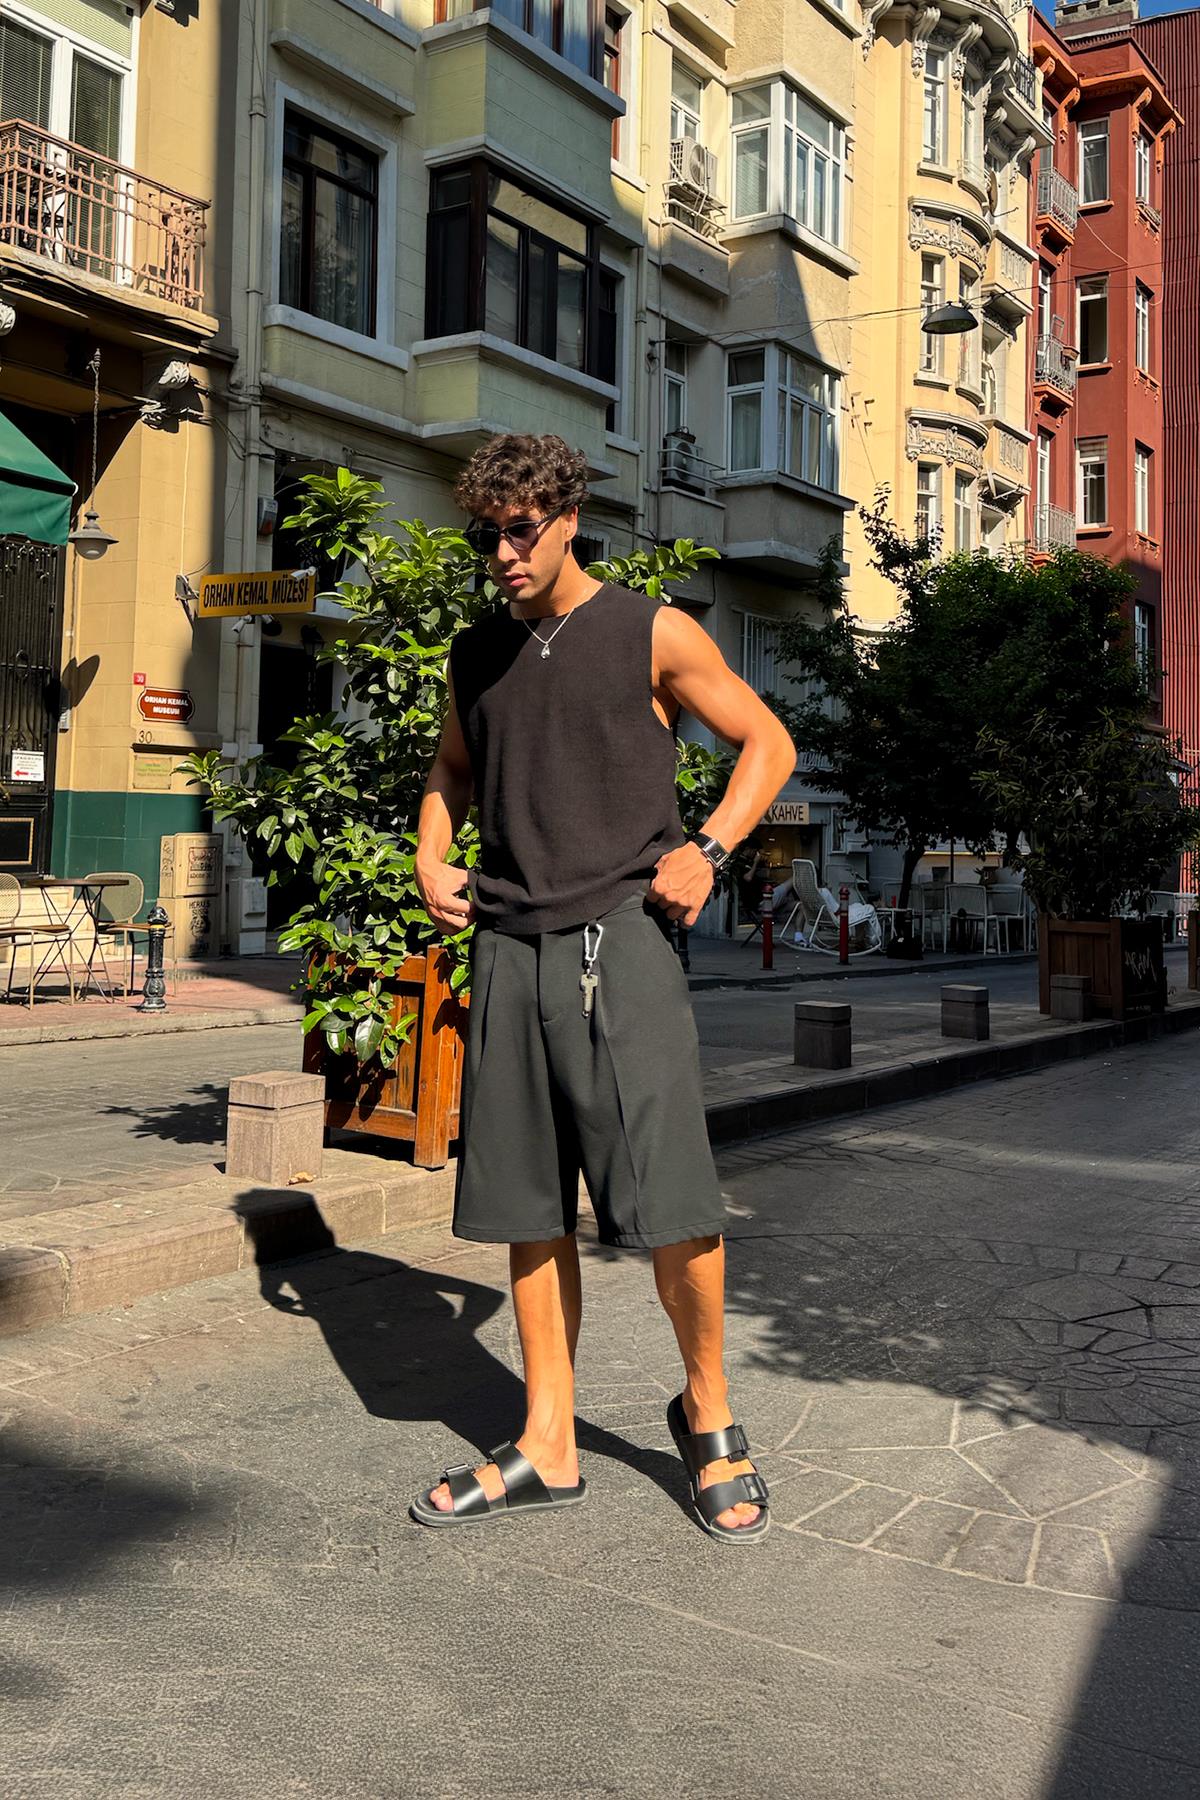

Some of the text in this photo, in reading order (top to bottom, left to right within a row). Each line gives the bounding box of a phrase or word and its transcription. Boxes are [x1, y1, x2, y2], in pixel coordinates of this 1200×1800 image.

[203, 573, 309, 608] ORHAN KEMAL MÜZESİ
[144, 695, 188, 707] ORHAN KEMAL
[152, 706, 180, 715] MUSEUM
[138, 730, 152, 744] 30
[771, 804, 804, 821] KAHVE
